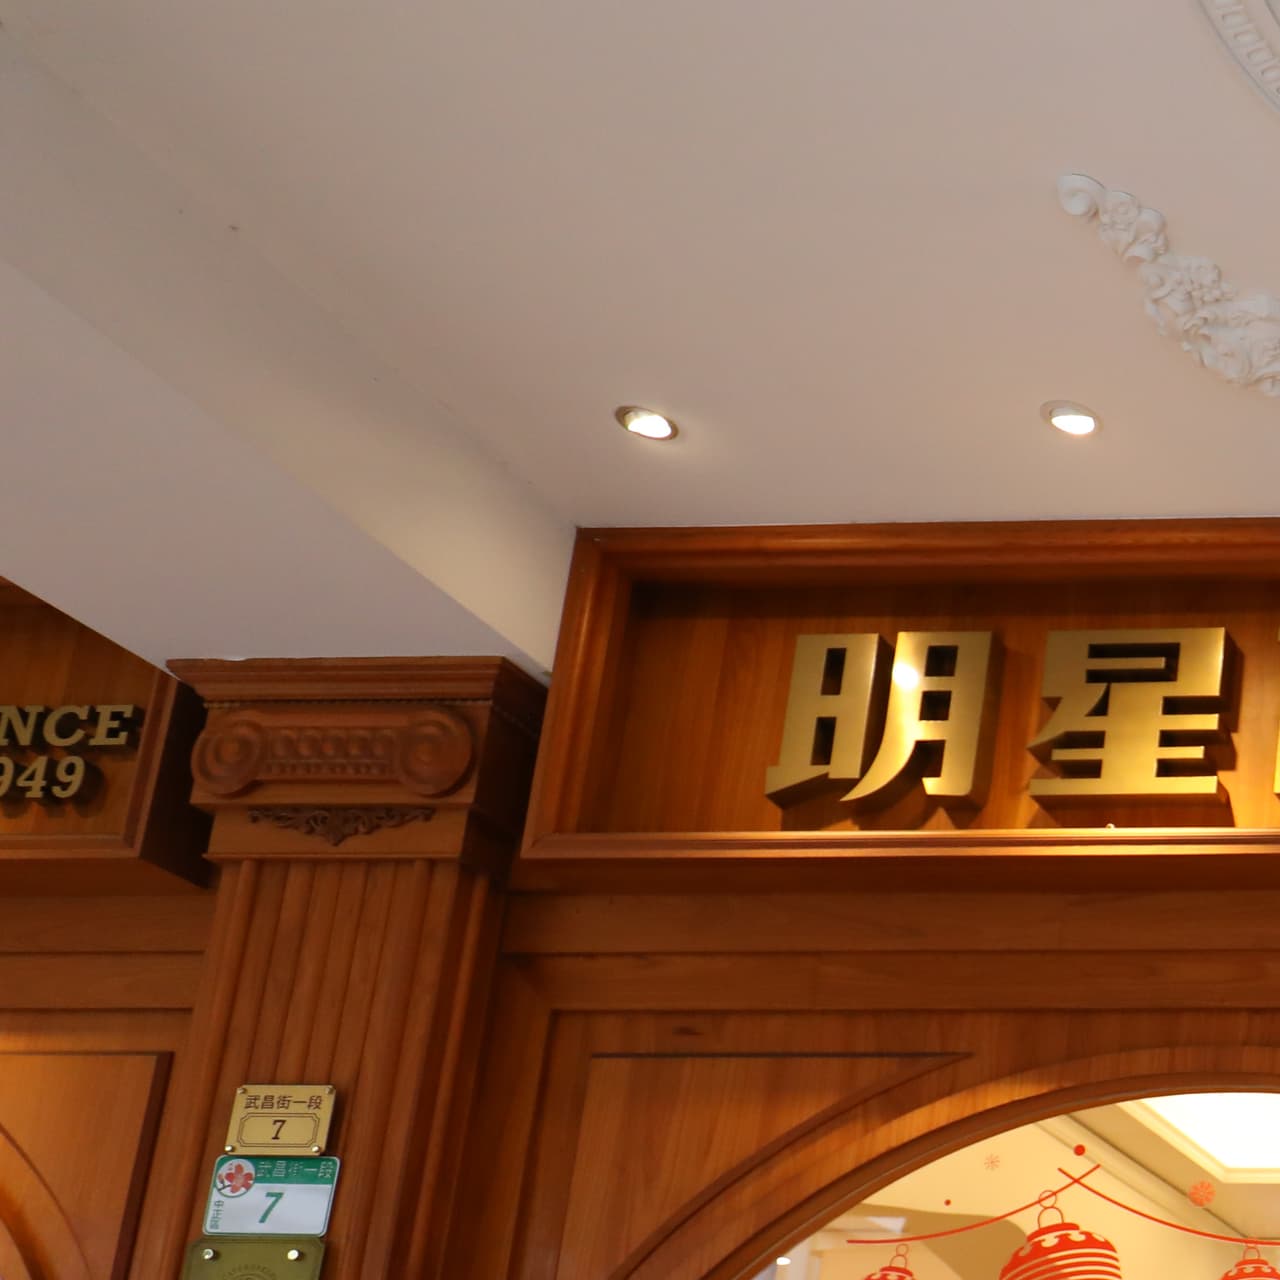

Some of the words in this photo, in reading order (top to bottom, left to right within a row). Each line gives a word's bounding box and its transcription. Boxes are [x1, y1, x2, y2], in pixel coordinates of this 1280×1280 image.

[244, 1095, 322, 1110] 武昌街一段
[271, 1119, 287, 1140] 7
[258, 1191, 285, 1224] 7
